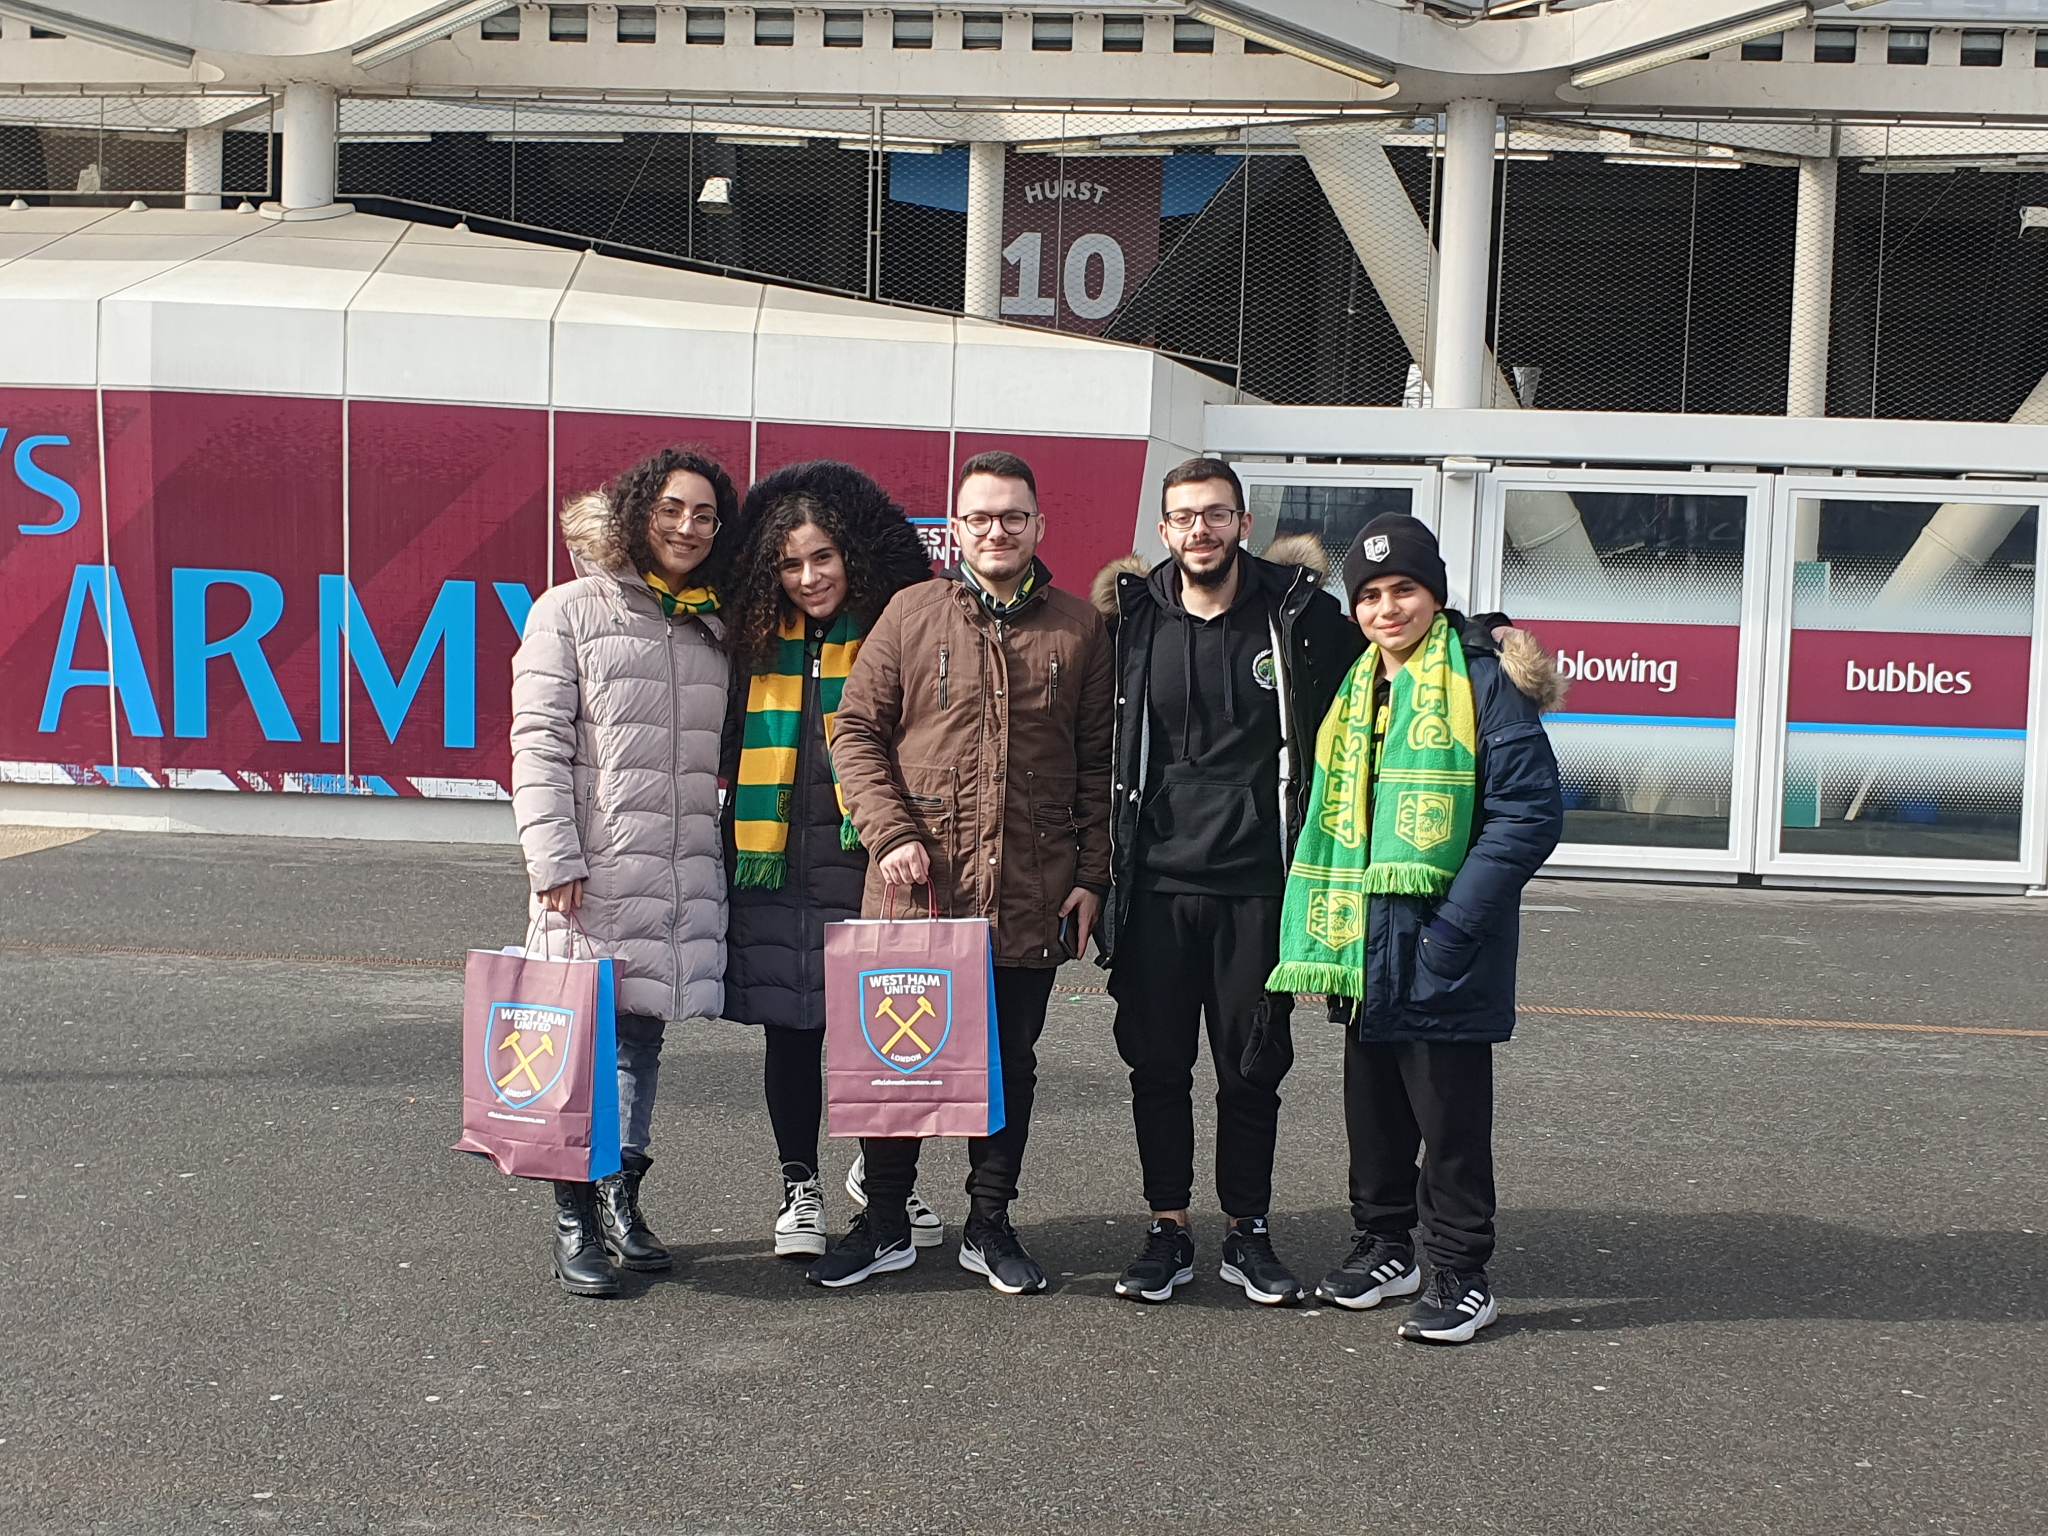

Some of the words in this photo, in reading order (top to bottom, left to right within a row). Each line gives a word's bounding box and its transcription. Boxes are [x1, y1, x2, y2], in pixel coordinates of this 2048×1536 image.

[1024, 180, 1110, 203] HURST
[1001, 231, 1126, 320] 10
[1556, 649, 1678, 693] blowing
[1846, 660, 1972, 695] bubbles
[1321, 733, 1366, 846] AEK
[869, 974, 905, 988] WEST
[907, 974, 941, 987] HAM
[884, 985, 926, 995] UNITED
[500, 1008, 536, 1021] WEST
[537, 1011, 567, 1027] HAM
[513, 1020, 552, 1032] UNITED
